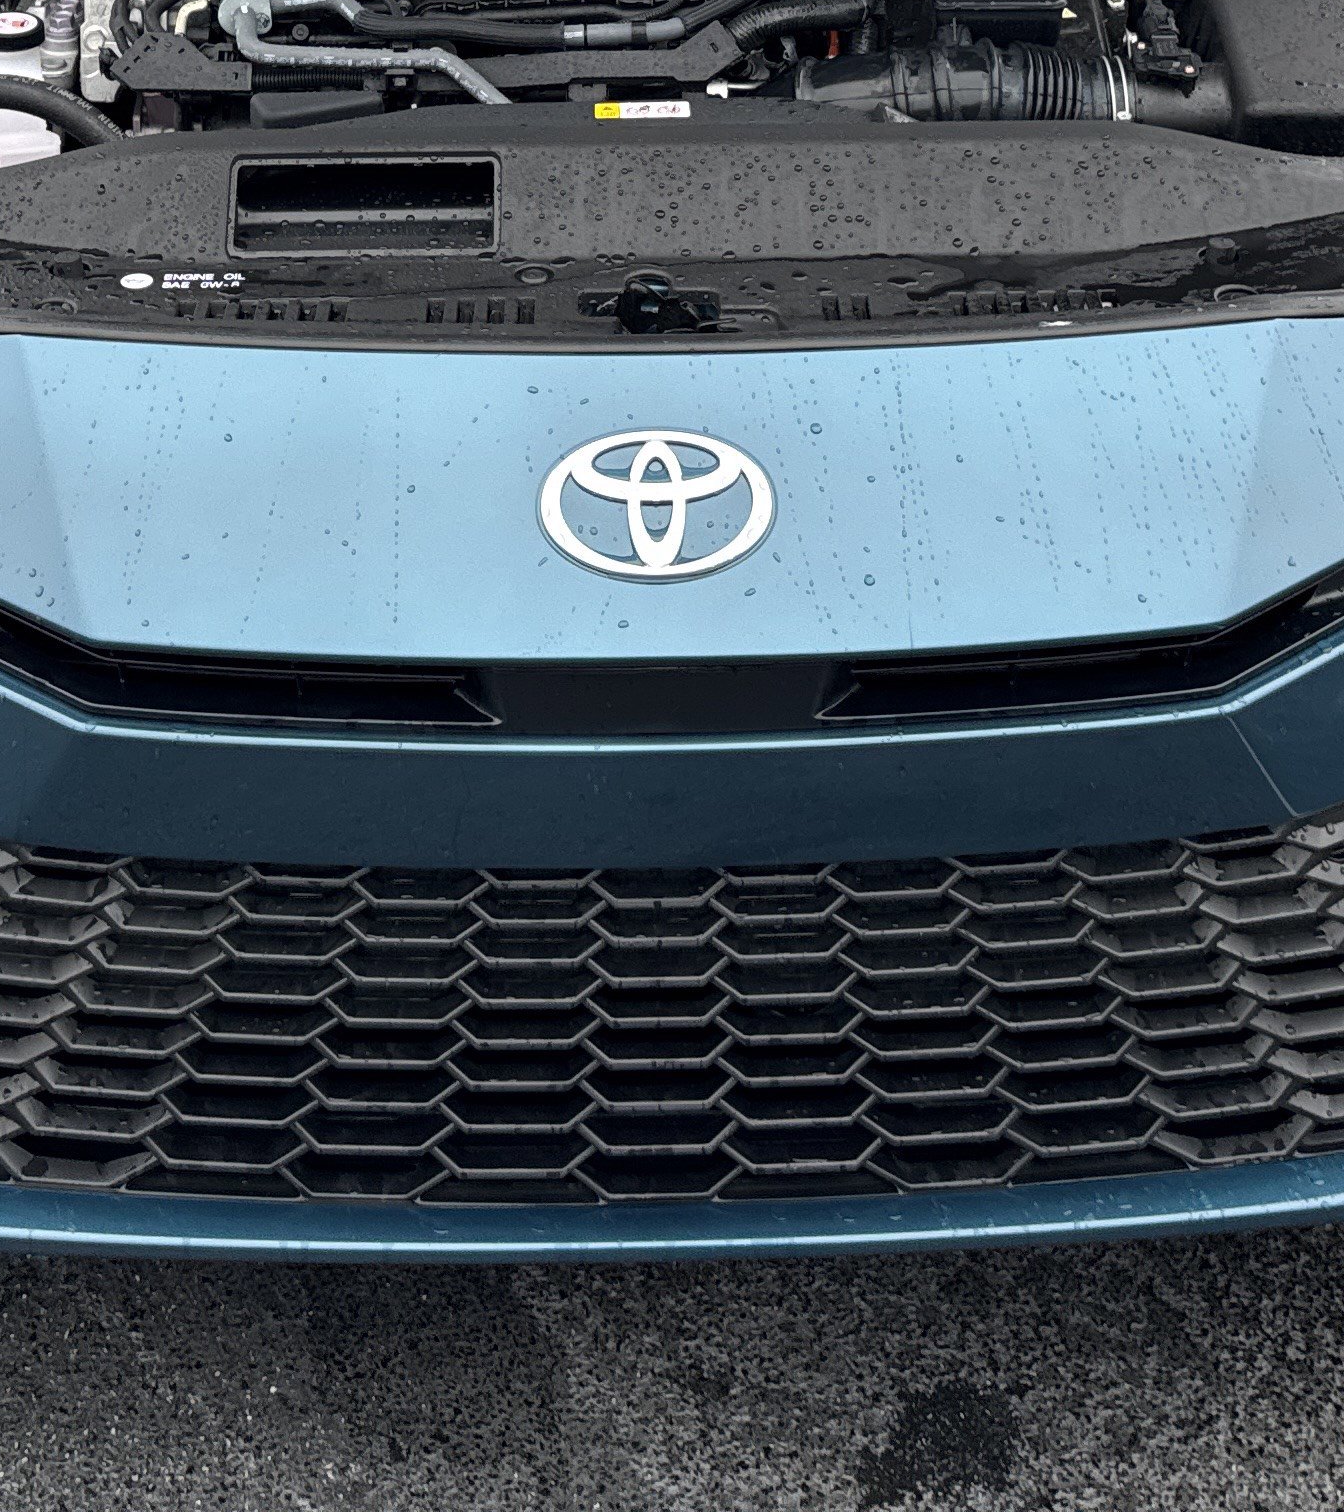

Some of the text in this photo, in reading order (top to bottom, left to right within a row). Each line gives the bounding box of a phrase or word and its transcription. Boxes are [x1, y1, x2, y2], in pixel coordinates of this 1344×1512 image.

[163, 273, 246, 281] ENGINE OIL
[161, 281, 191, 289] SAE
